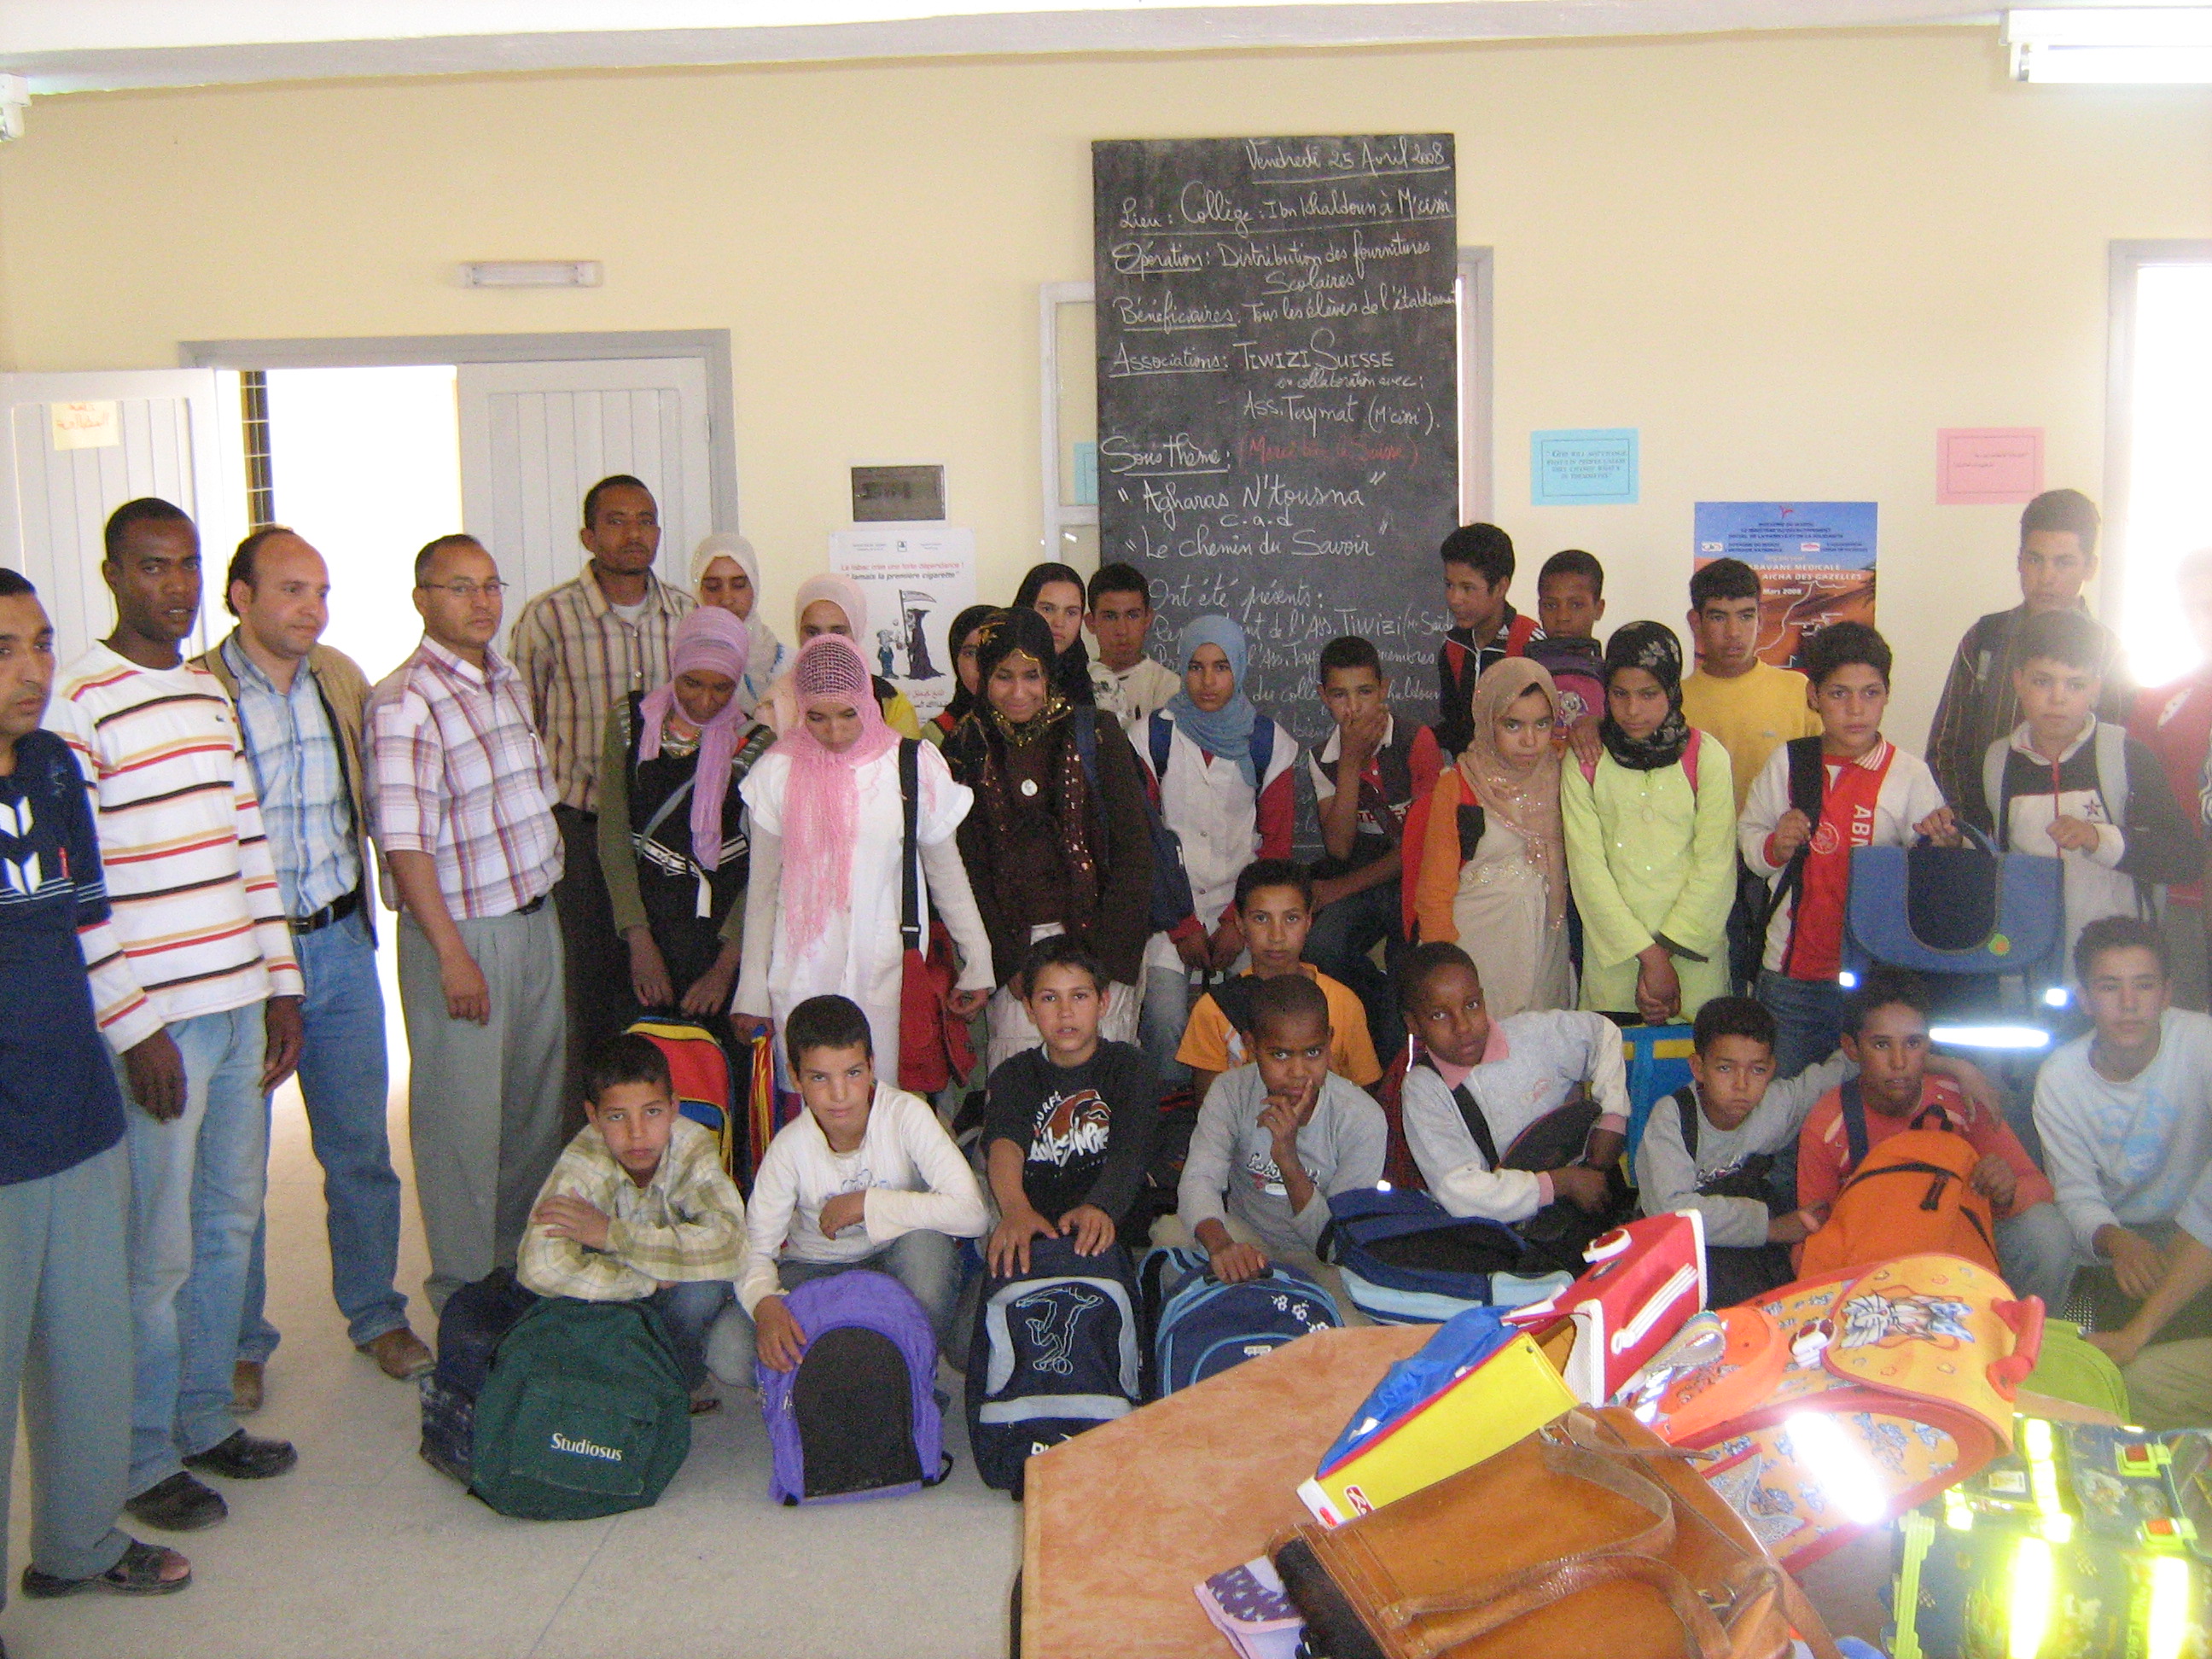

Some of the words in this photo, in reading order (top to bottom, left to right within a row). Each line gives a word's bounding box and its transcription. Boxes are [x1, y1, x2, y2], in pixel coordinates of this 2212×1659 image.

[1245, 138, 1321, 171] Vendredi
[1328, 150, 1354, 171] 25
[1362, 137, 1408, 178] Avril
[1412, 142, 1446, 166] 2008
[1216, 242, 1322, 267] Distribution
[1326, 238, 1348, 263] des
[1353, 229, 1431, 280] fournitures
[1242, 300, 1278, 323] Tous
[1283, 296, 1304, 321] les
[1306, 291, 1358, 319] élèves
[1362, 289, 1379, 315] de
[1101, 436, 1163, 473] Sous
[1259, 531, 1282, 556] du
[1148, 573, 1194, 611] Ont
[1198, 573, 1240, 608] été
[550, 1432, 624, 1462] Studiosus
